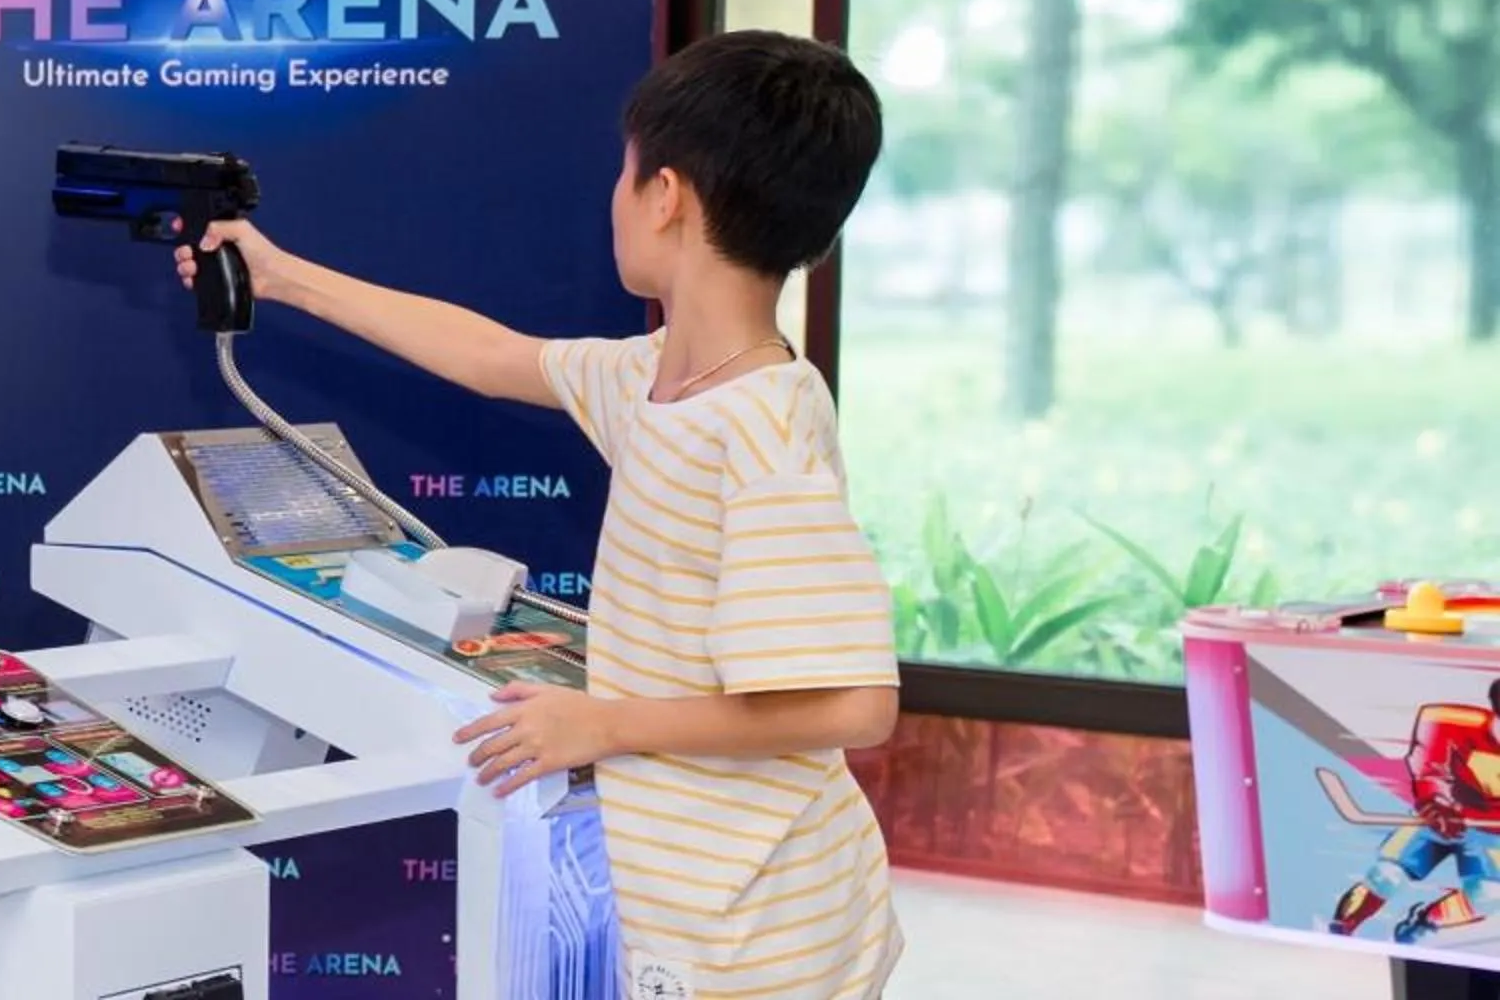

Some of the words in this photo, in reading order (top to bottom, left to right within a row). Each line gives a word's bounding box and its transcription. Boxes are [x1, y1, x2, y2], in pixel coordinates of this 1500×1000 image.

[23, 59, 149, 88] Ultimate
[159, 59, 277, 93] Gaming
[288, 59, 450, 93] Experience
[410, 475, 465, 498] THE
[474, 475, 571, 498] ARENA
[527, 572, 593, 595] AREN
[403, 858, 457, 881] THE
[269, 952, 297, 974] HE
[306, 953, 402, 976] ARENA
